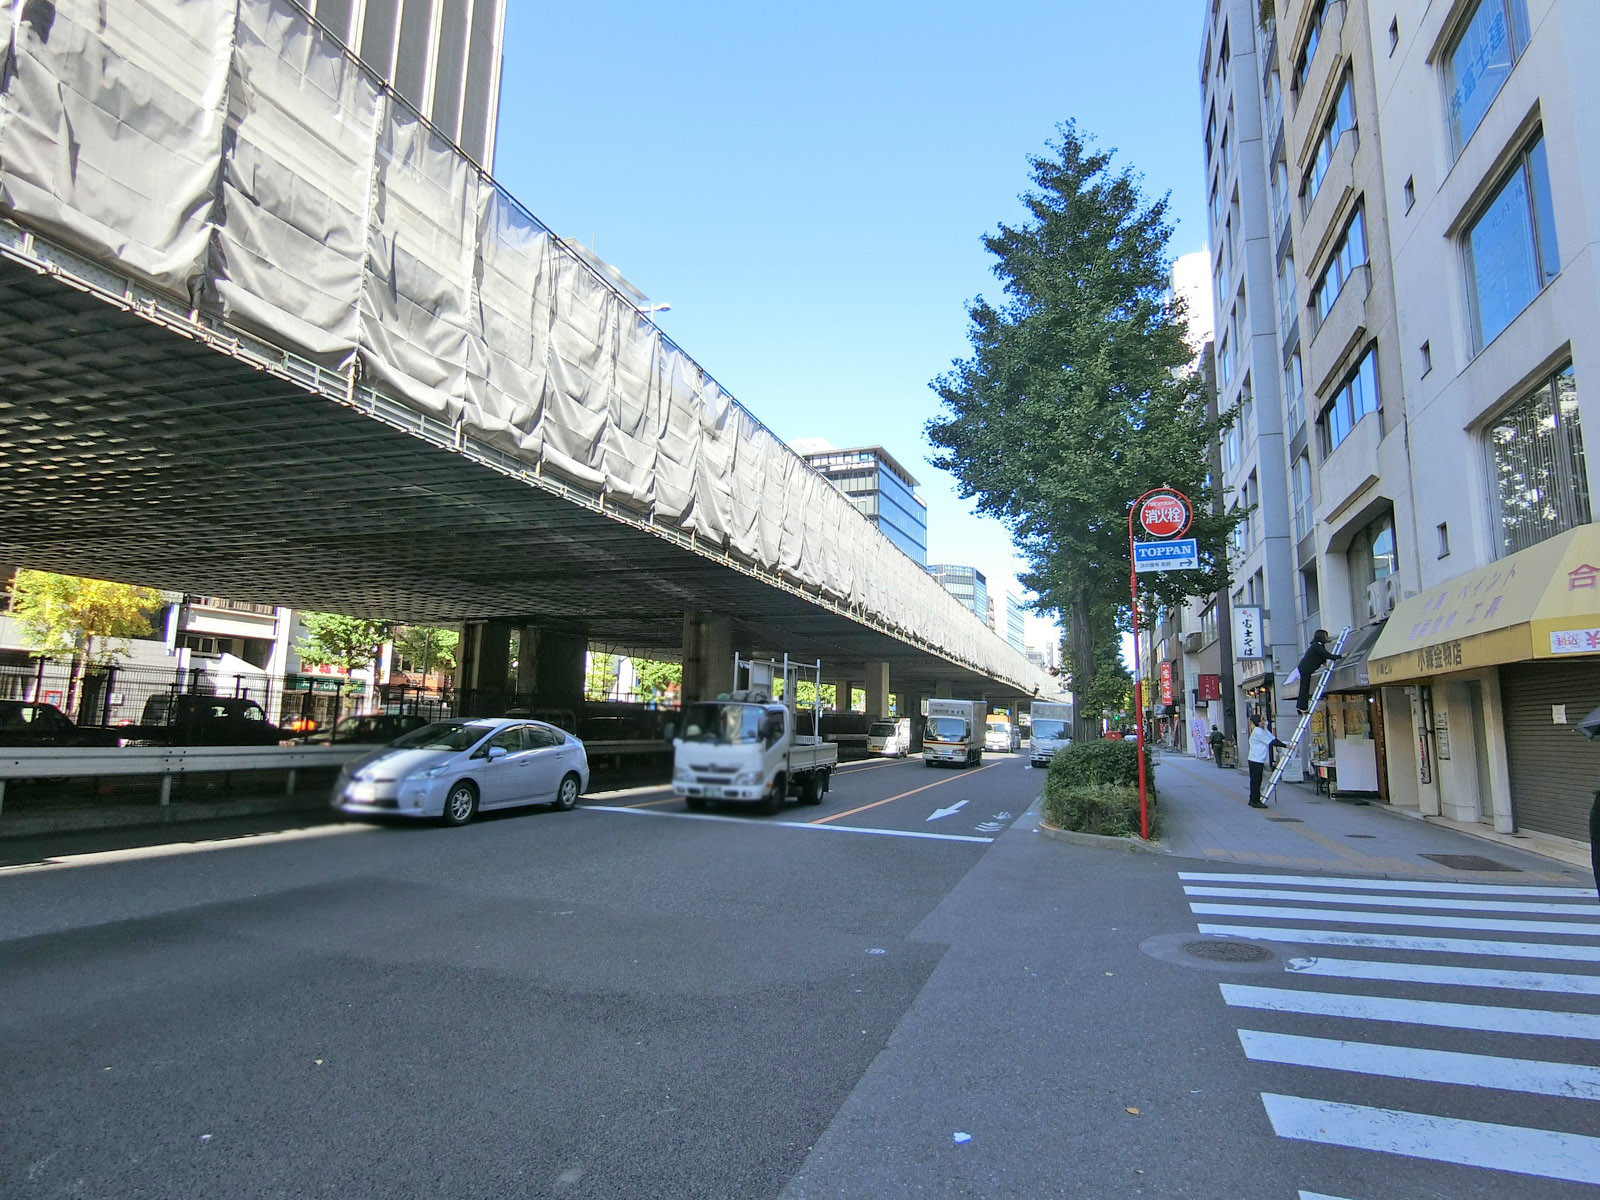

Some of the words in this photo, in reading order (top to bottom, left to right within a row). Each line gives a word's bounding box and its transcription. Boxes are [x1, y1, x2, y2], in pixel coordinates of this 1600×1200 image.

[1145, 507, 1181, 524] 消火栓
[1138, 545, 1192, 557] TOPPAN
[1242, 619, 1255, 656] 富士そば
